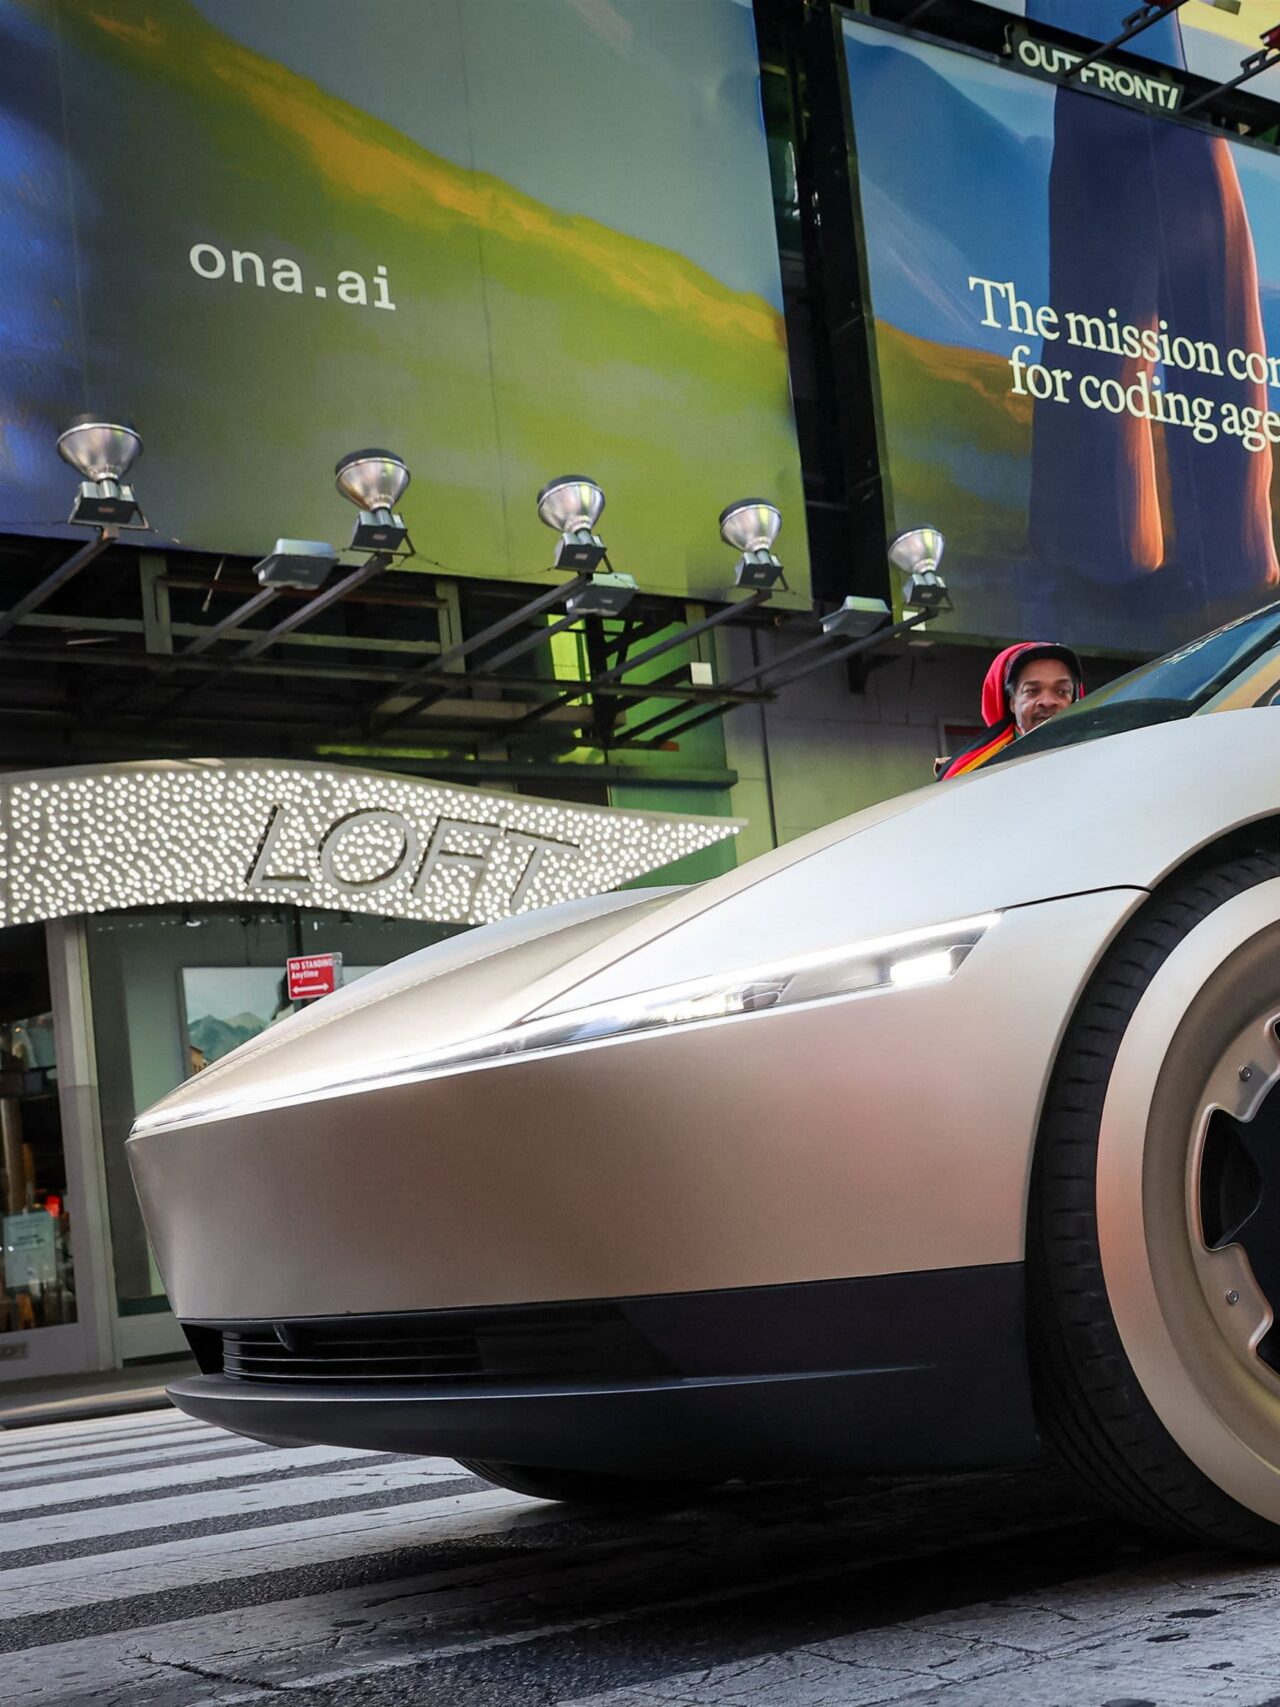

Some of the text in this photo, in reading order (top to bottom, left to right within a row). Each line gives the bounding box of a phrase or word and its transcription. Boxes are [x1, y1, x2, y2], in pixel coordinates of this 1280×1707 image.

[189, 243, 396, 311] ona.ai
[968, 276, 1060, 341] The
[1065, 308, 1224, 377] mission
[1008, 344, 1072, 404] for
[1079, 371, 1218, 444] coding
[244, 803, 580, 908] LOFT
[290, 958, 335, 971] NO STANDING
[291, 970, 319, 984] Anytime
